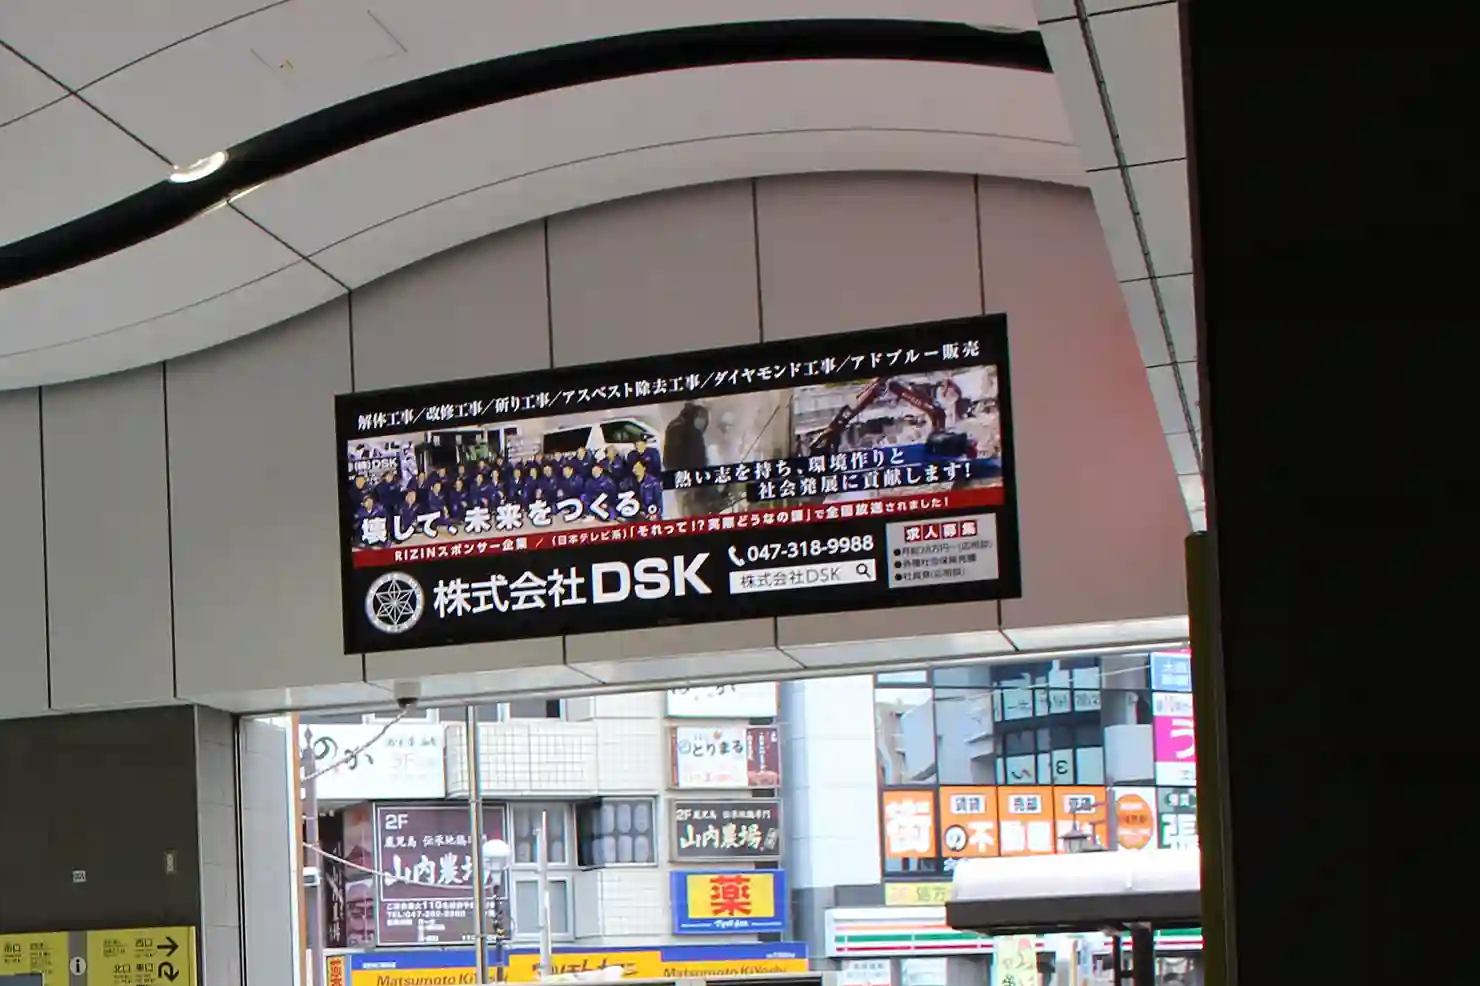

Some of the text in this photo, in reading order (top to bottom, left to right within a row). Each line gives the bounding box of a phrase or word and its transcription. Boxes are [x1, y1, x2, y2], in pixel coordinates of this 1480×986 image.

[362, 491, 659, 544] 壊して、未来をつくる。
[747, 534, 874, 562] 047-318-9988
[740, 567, 841, 589] 株式会社DSK
[385, 813, 409, 830] 2F
[680, 822, 762, 851] 山内農場
[710, 875, 752, 916] 薬
